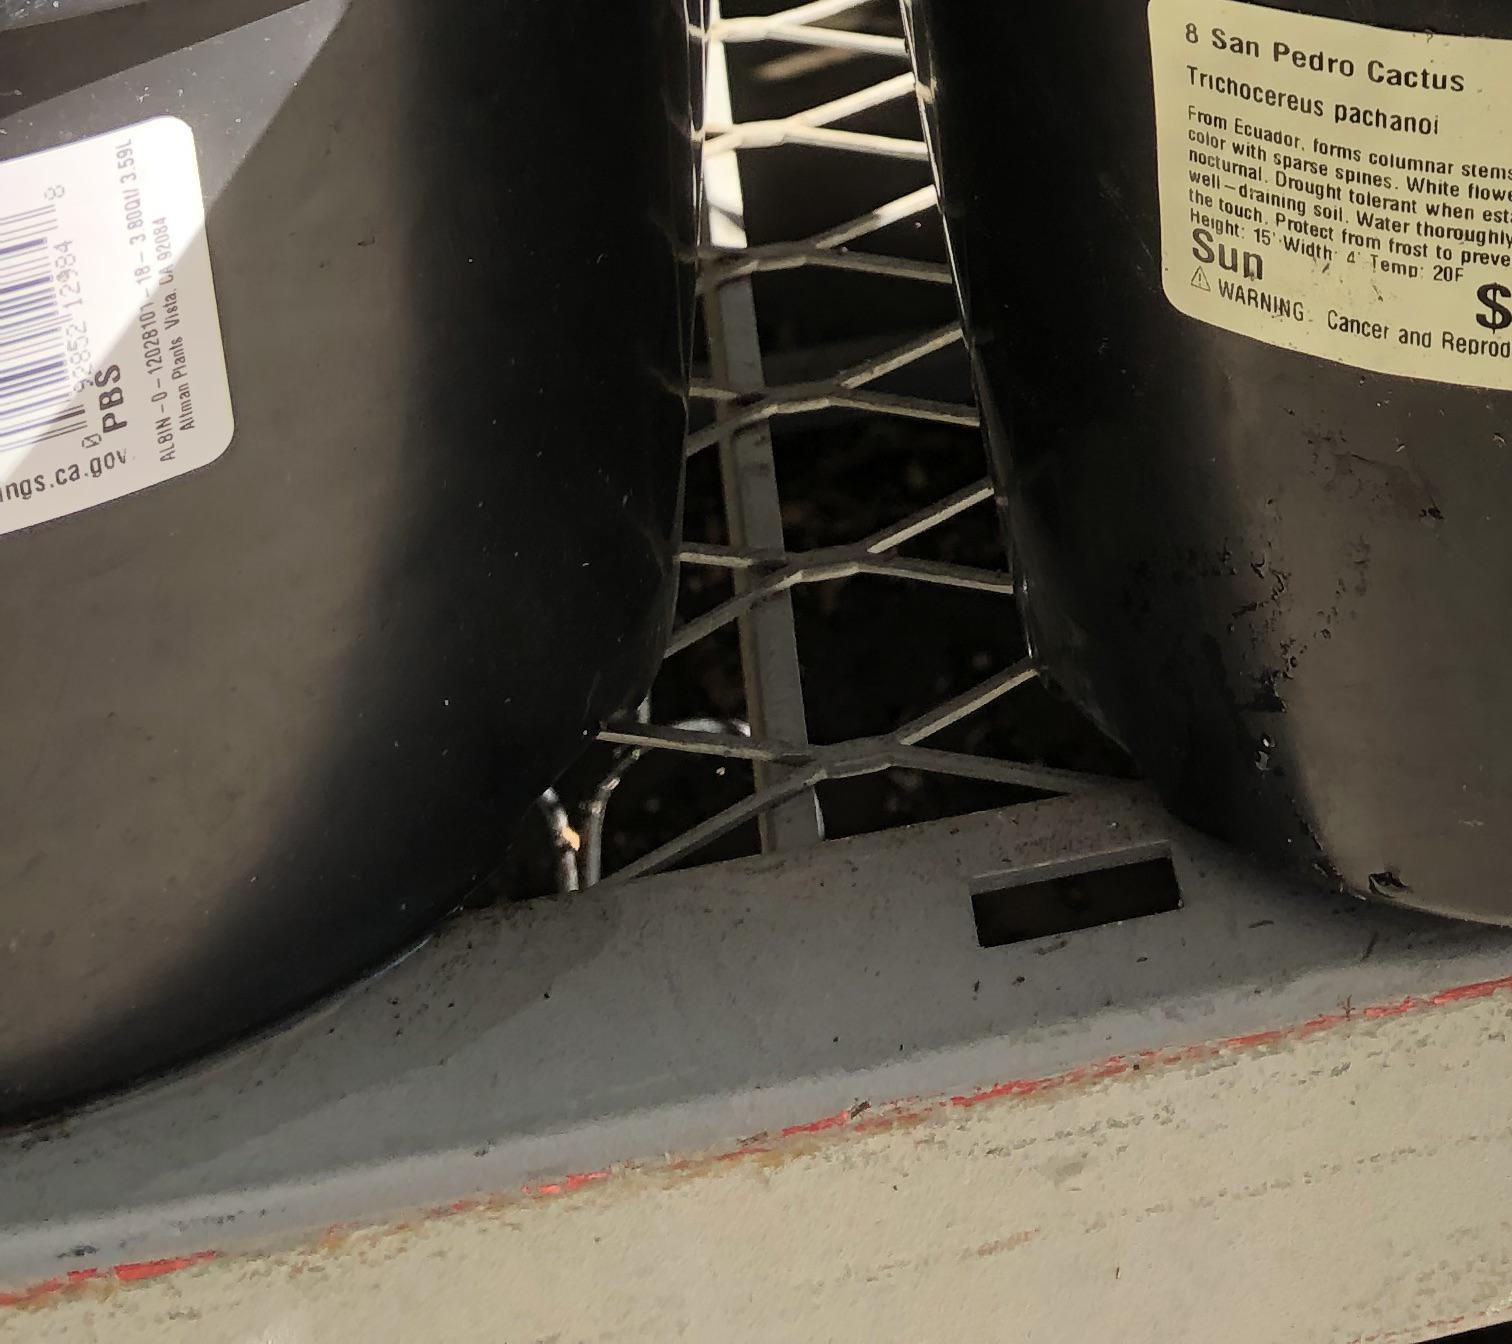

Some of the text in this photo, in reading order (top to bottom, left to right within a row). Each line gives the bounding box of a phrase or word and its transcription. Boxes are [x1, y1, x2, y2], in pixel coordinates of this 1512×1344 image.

[1185, 22, 1465, 92] 8 San Pedro Cactus
[1186, 64, 1439, 135] Trichocereus pachanoi
[1187, 105, 1228, 130] From
[1313, 137, 1362, 162] forms
[1368, 152, 1454, 175] columnar
[1188, 128, 1227, 150] color
[1232, 140, 1267, 162] with
[1273, 152, 1328, 177] sparse
[1335, 166, 1399, 190] spines.
[1406, 175, 1460, 197] White
[1189, 148, 1269, 184] nocturnal.
[1275, 170, 1342, 201] Drought
[1348, 188, 1417, 214] tolerant
[1425, 202, 1475, 220] when
[1189, 187, 1213, 207] the
[1275, 211, 1334, 235] Protect
[1341, 227, 1381, 251] from
[1388, 237, 1429, 258] frost
[1435, 244, 1453, 261] to
[1190, 208, 1246, 238] Height:
[1433, 264, 1465, 282] 20F
[1191, 227, 1264, 280] Sun
[1356, 210, 1411, 234] Water
[1327, 309, 1390, 340] Cancer
[1398, 327, 1432, 349] and
[94, 364, 128, 433] PBS
